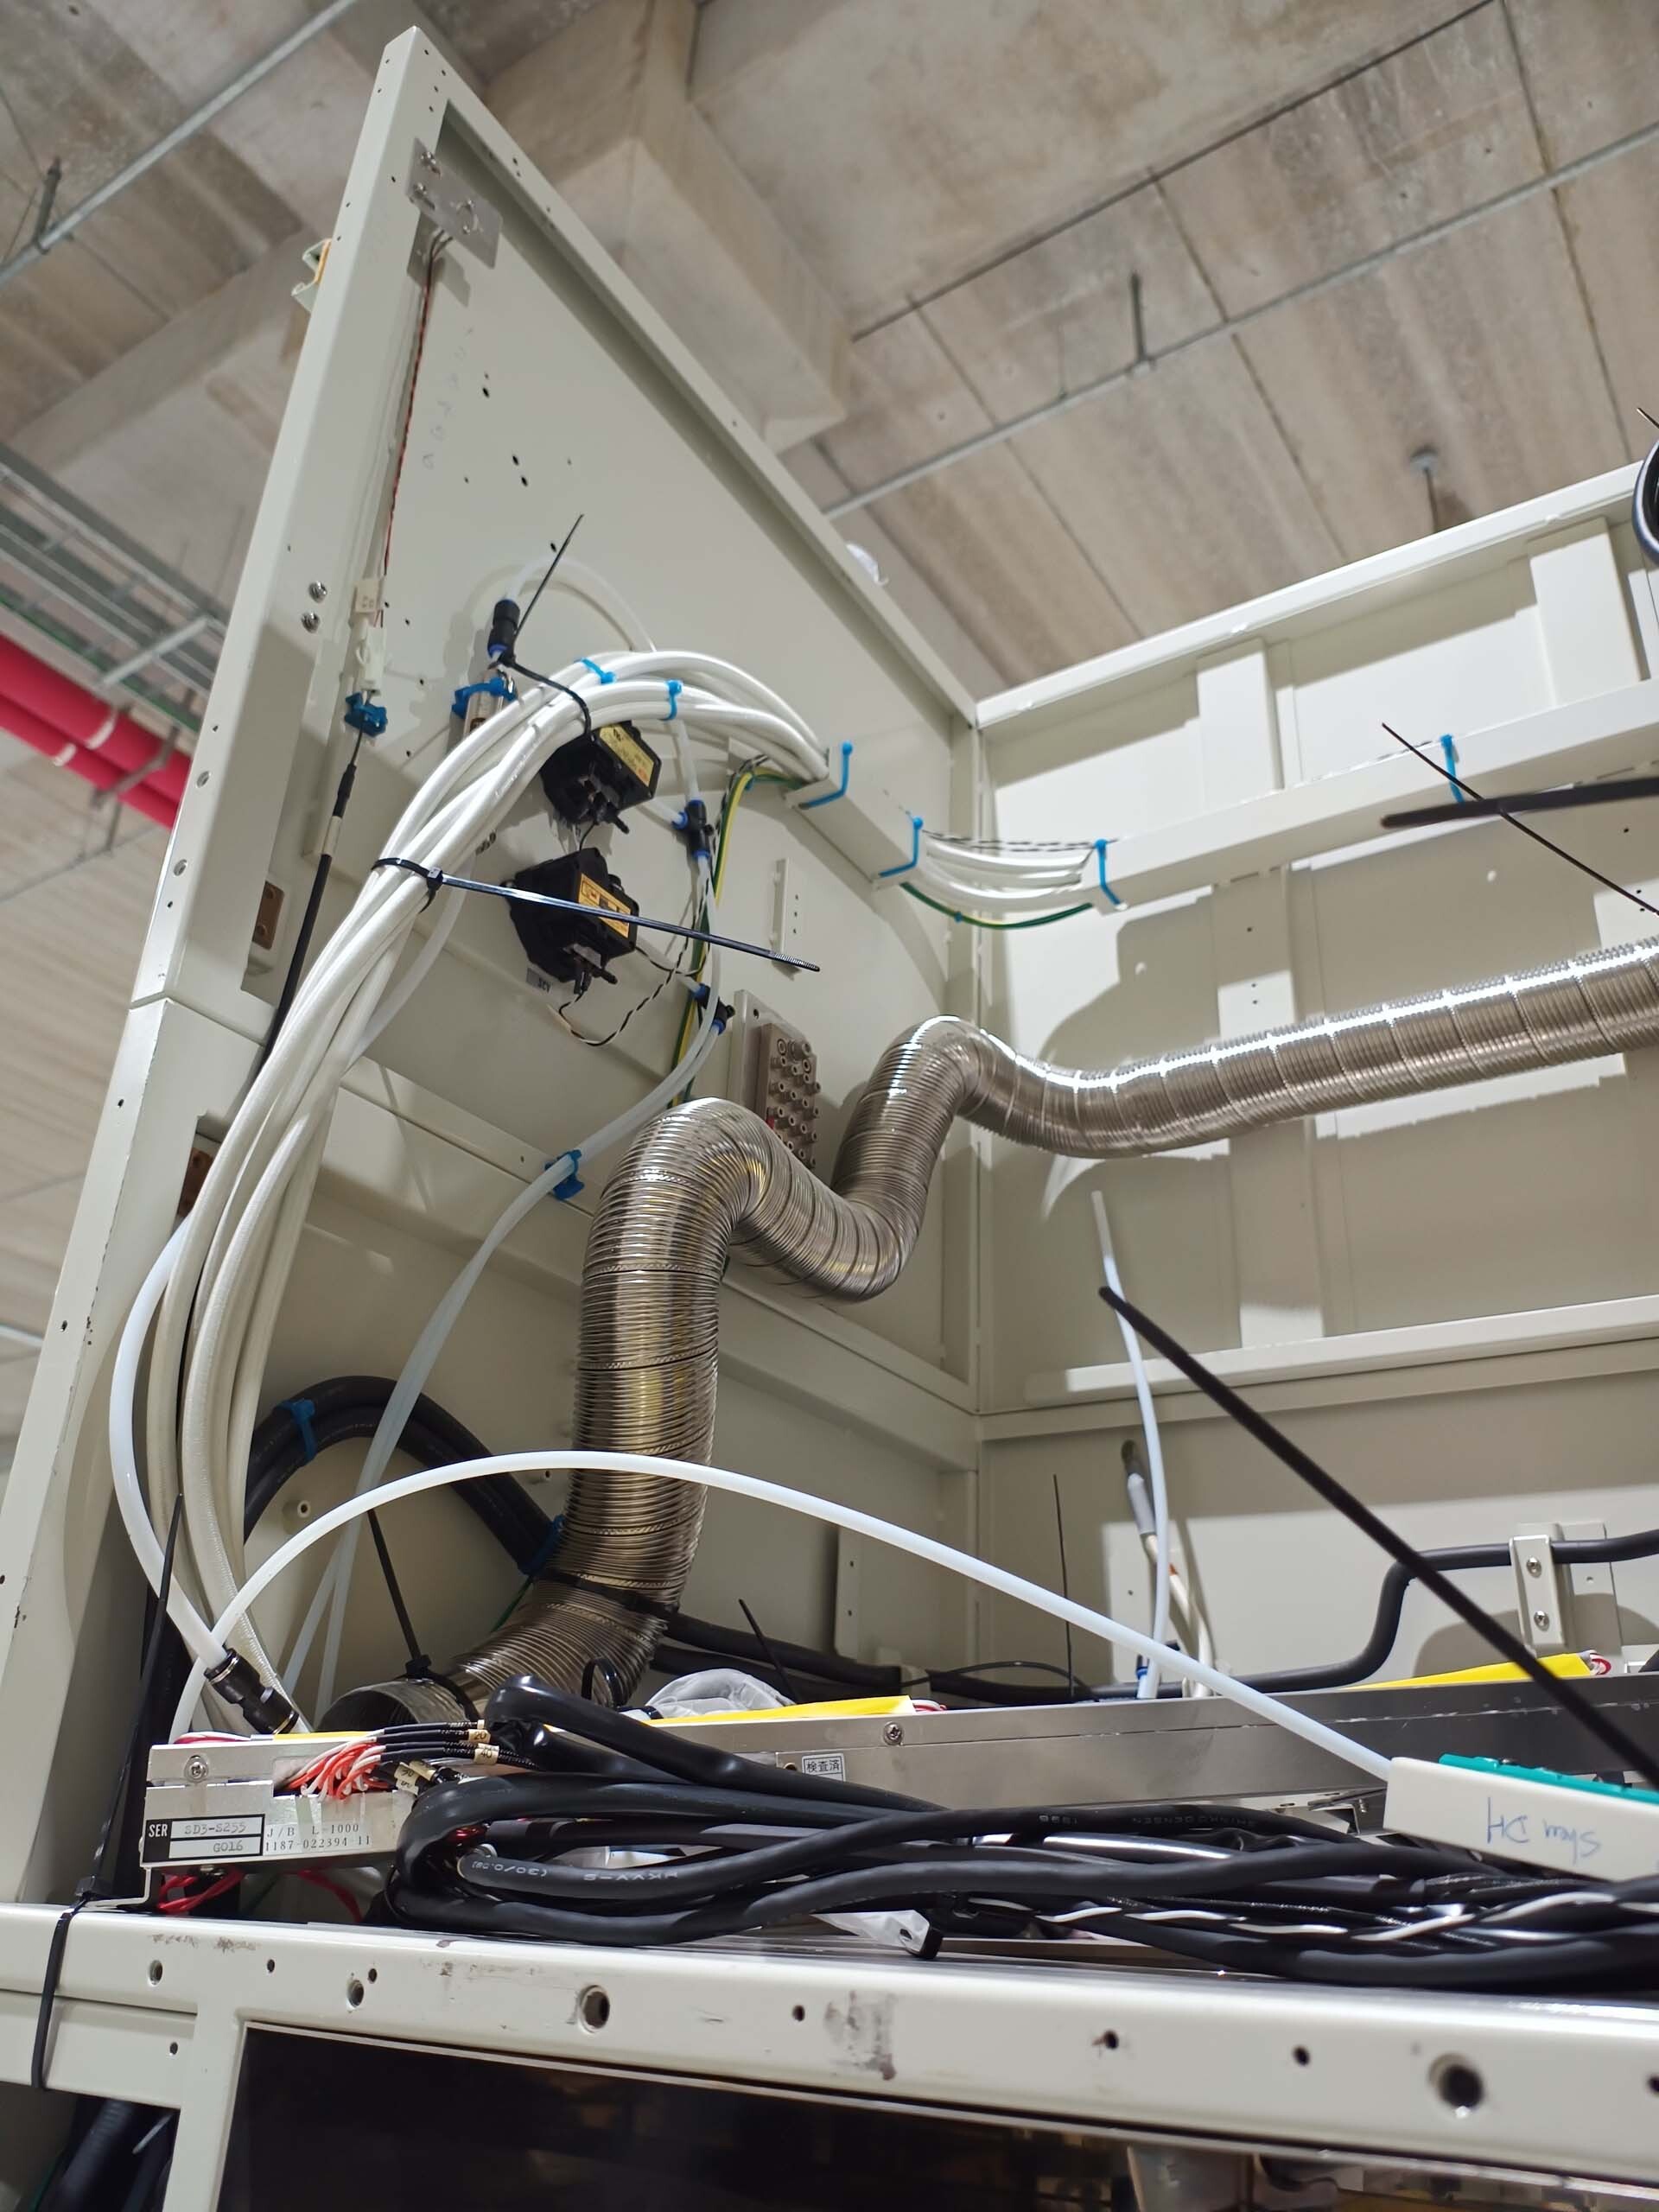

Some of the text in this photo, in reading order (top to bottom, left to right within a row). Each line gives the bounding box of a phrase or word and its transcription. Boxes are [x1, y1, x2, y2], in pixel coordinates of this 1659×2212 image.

[806, 1759, 840, 1773] 検査済
[148, 1823, 168, 1838] SER
